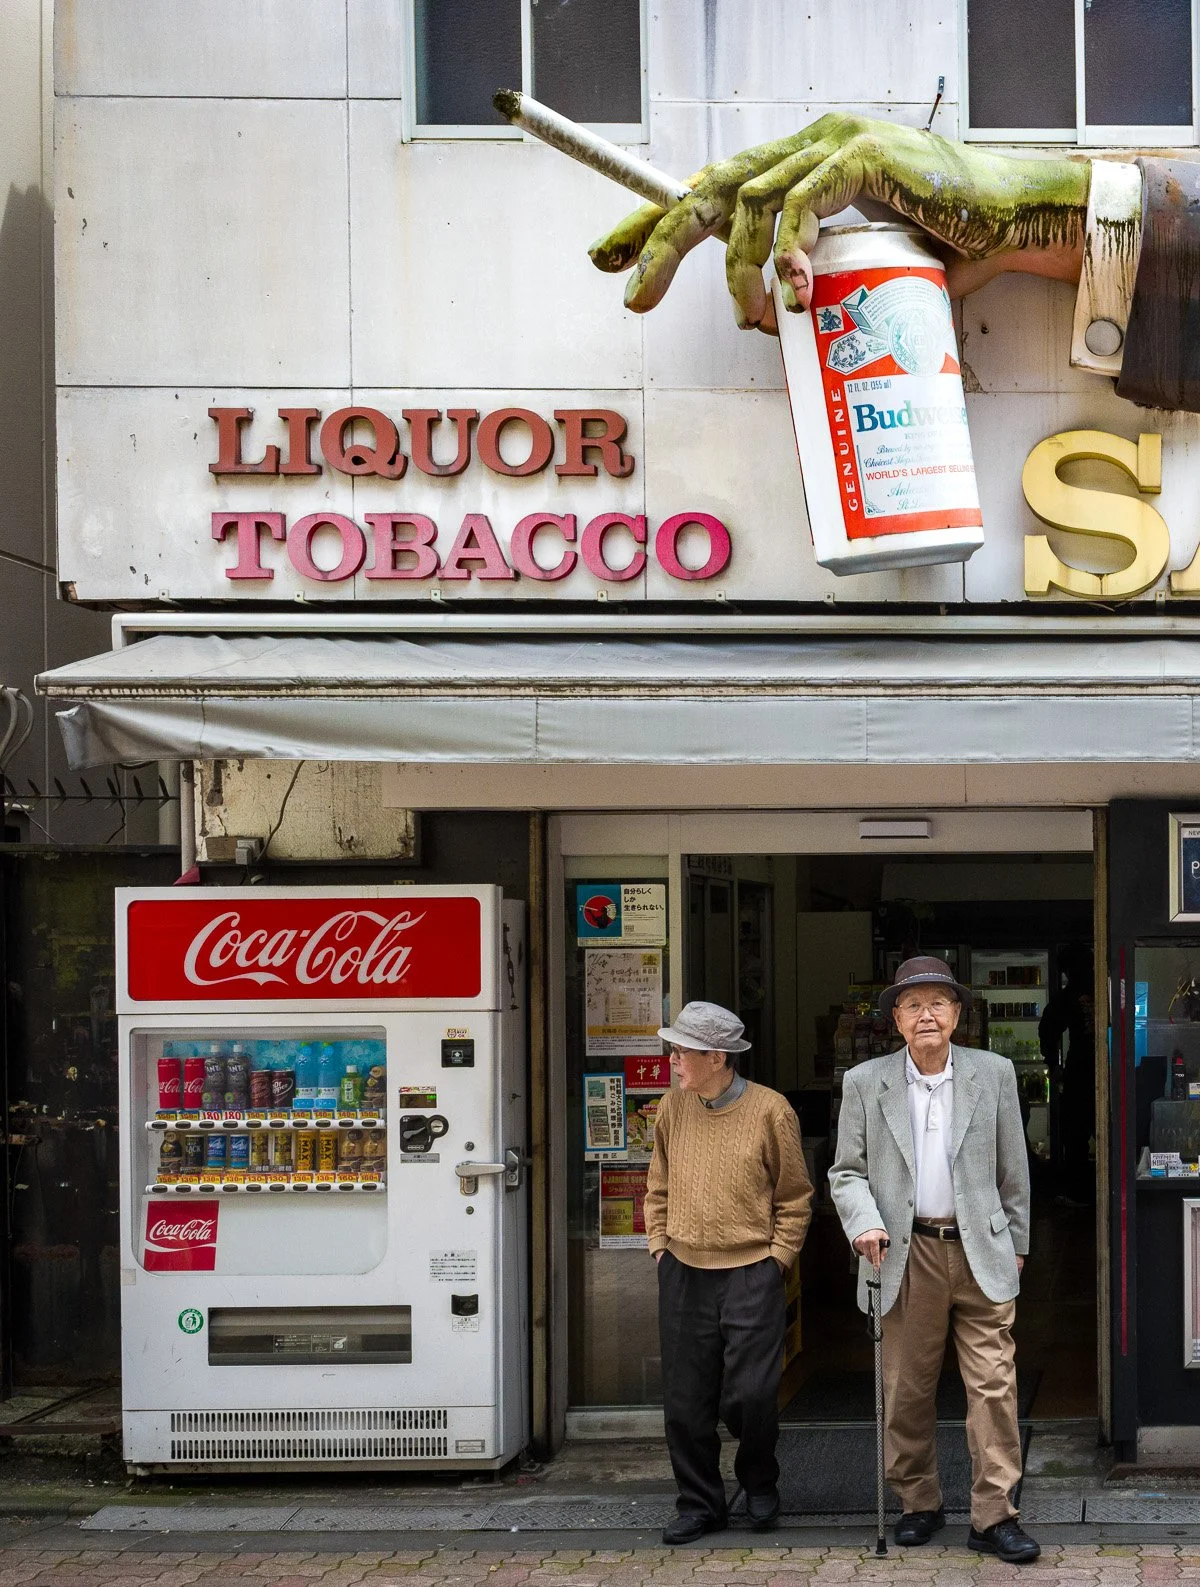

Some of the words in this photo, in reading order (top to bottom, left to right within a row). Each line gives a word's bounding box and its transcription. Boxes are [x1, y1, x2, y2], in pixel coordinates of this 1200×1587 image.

[847, 383, 853, 393] 12
[208, 407, 635, 480] LIQUOR
[833, 388, 859, 511] GENUINE
[866, 469, 907, 480] WORLD'S
[911, 465, 947, 476] LARGEST
[211, 512, 732, 582] TOBACCO
[624, 887, 652, 895] 自分らしく
[624, 904, 665, 912] 生きられない。
[183, 909, 427, 987] Coca-Cola
[203, 1111, 220, 1120] 180
[224, 1111, 241, 1120] 180
[324, 1139, 332, 1161] MAX
[631, 1175, 648, 1184] SUPE
[147, 1217, 213, 1243] Coca-Cola
